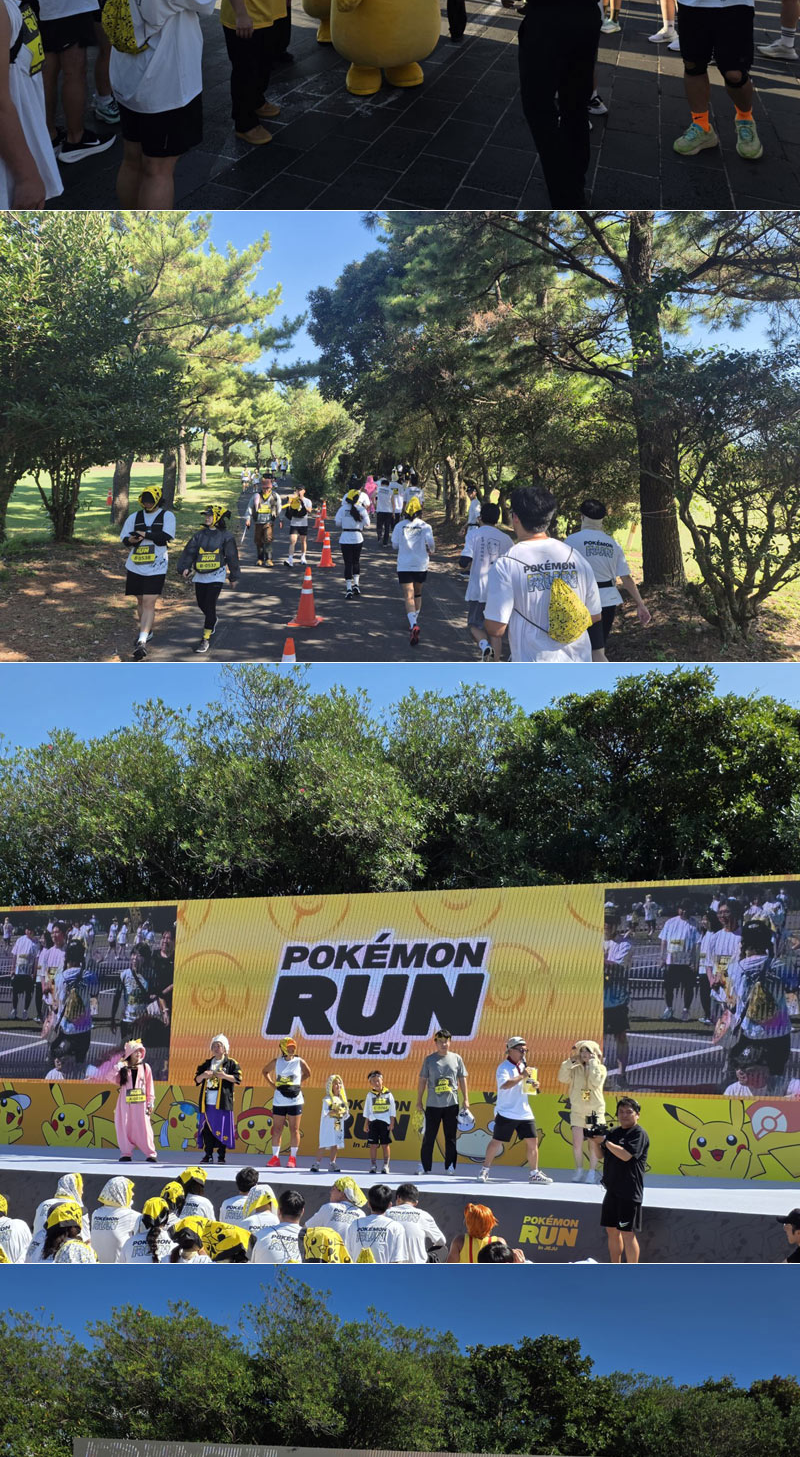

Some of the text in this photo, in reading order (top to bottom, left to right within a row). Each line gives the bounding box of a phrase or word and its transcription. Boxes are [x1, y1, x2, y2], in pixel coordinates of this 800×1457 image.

[583, 540, 614, 549] POKÉMON
[523, 559, 576, 574] POKÉMON
[280, 932, 488, 971] POKÉMON
[264, 972, 486, 1037] RUN
[356, 1041, 407, 1056] JEJU
[523, 1214, 580, 1228] POKÉMON
[518, 1225, 579, 1247] RUN
